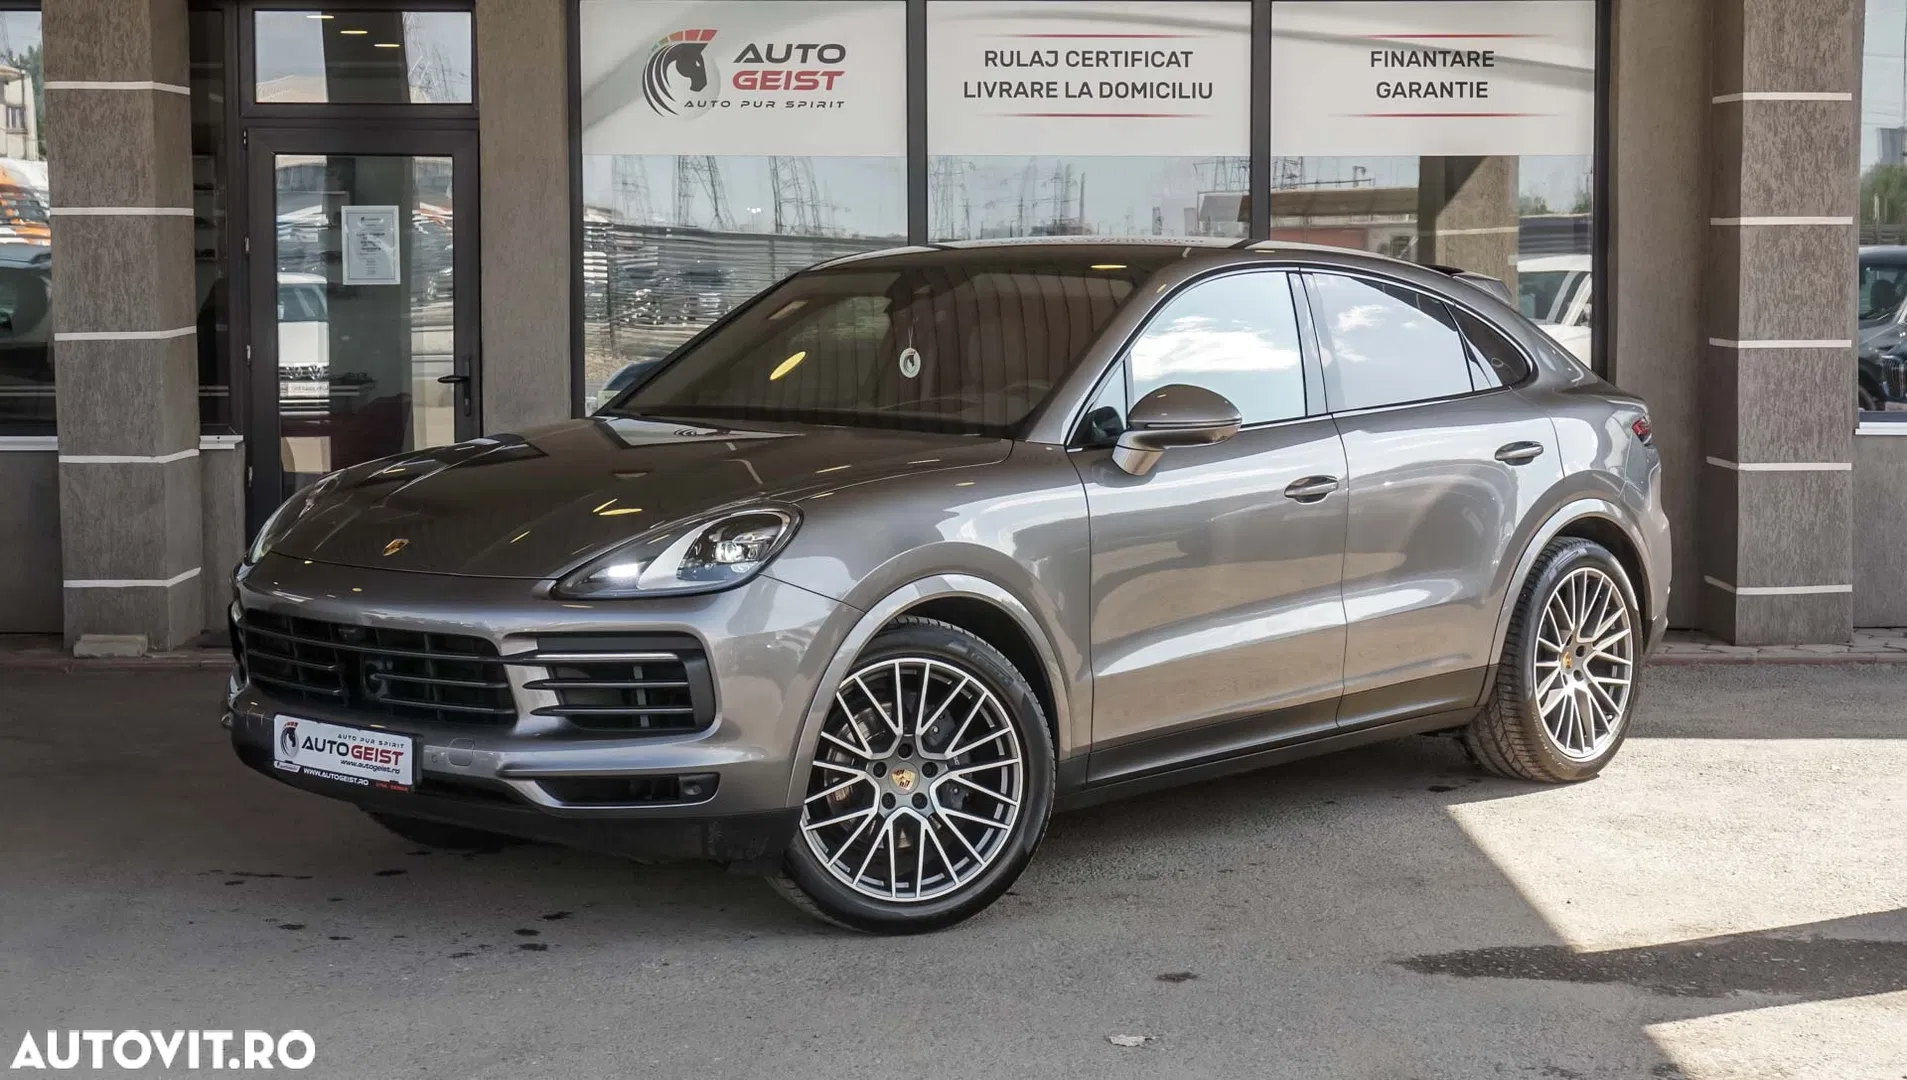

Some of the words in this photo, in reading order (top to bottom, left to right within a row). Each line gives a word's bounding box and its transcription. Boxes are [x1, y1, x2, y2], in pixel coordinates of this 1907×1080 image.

[733, 43, 846, 64] AUTO
[984, 50, 1059, 68] RULAJ
[1065, 50, 1194, 68] CERTIFICAT
[1370, 50, 1495, 68] FINANTARE
[732, 70, 846, 91] GEIST
[963, 81, 1059, 99] LIVRARE
[1065, 81, 1094, 99] LA
[1099, 81, 1214, 100] DOMICILIU
[1376, 81, 1489, 99] GARANTIE
[684, 100, 732, 109] AUTO
[740, 100, 776, 109] PUR
[785, 100, 845, 109] SPIRIT
[337, 733, 357, 741] AUTO
[378, 740, 405, 749] SPIRIT
[303, 768, 369, 786] WWW.AUTOGEIST.RO
